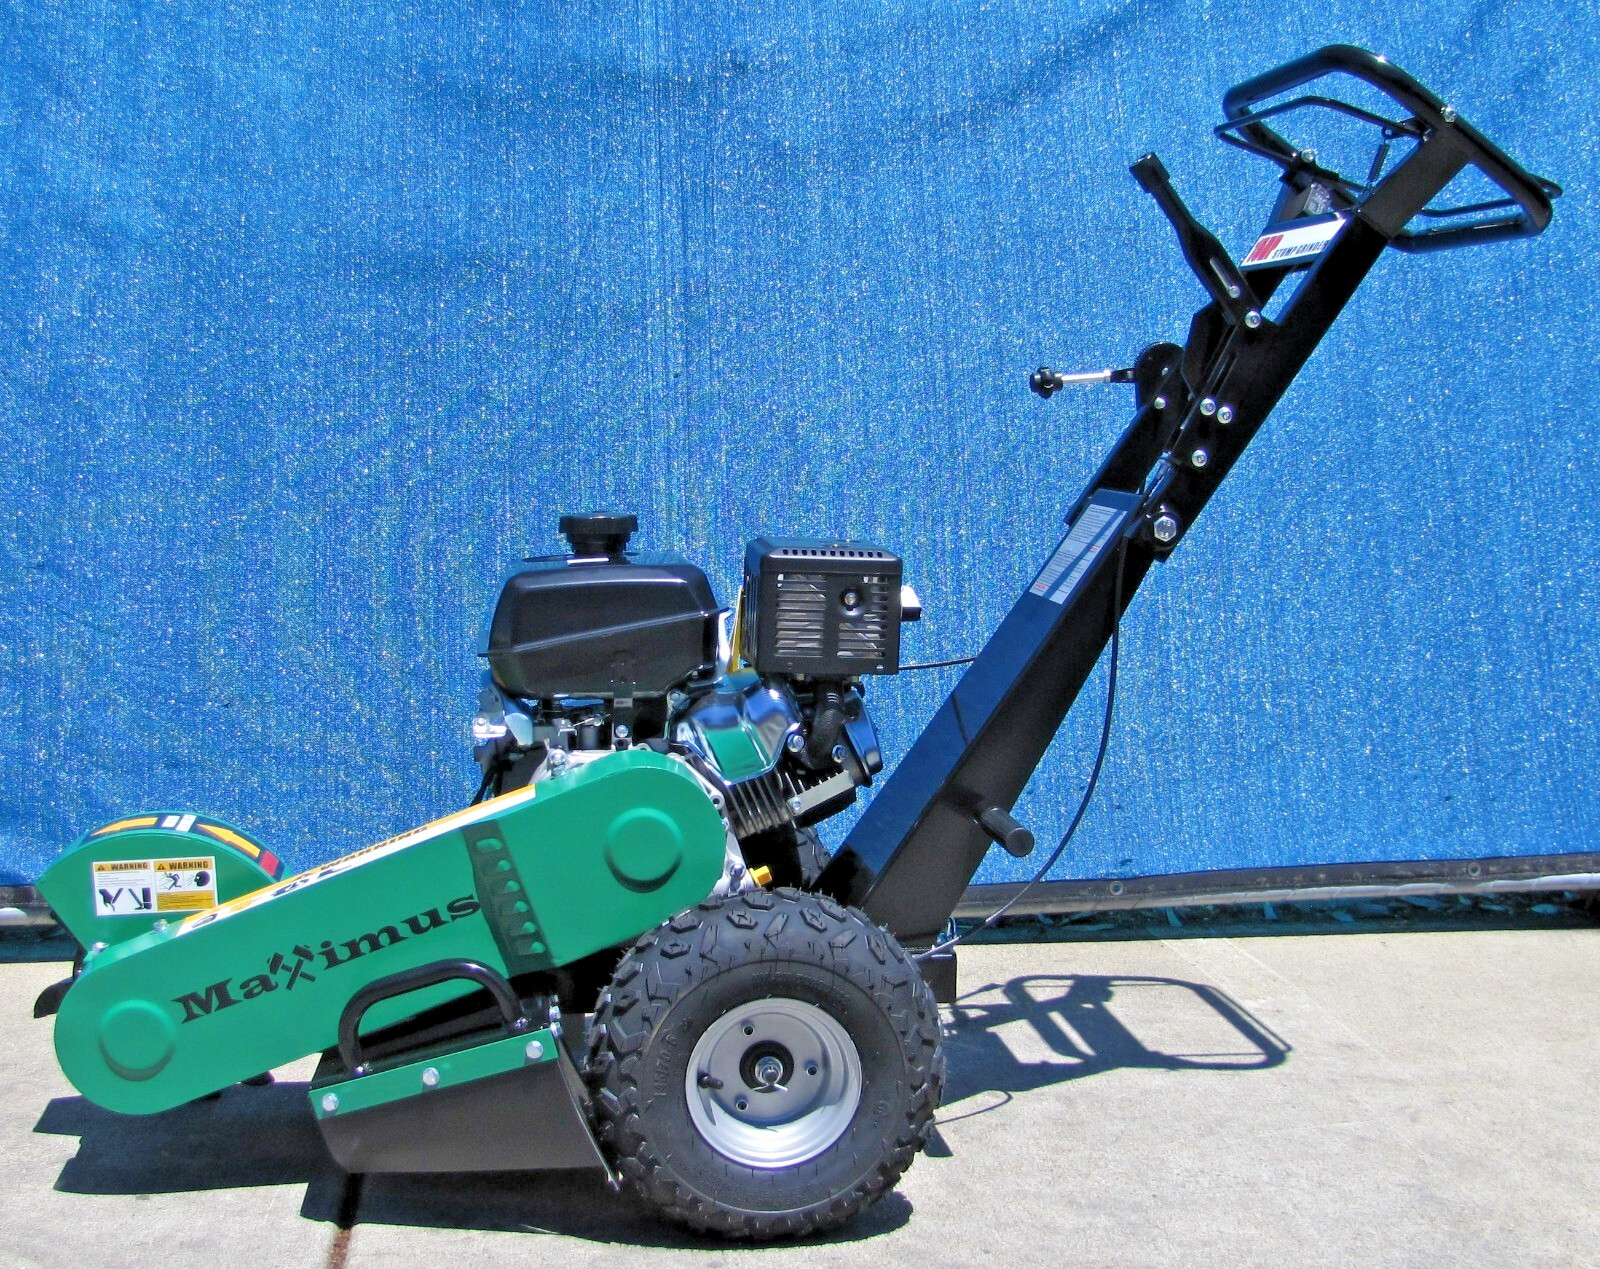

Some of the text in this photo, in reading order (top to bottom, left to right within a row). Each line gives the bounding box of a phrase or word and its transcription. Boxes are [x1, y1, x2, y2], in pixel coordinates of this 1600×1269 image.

[1271, 246, 1298, 259] STUMP
[111, 862, 148, 871] WARNING
[169, 860, 209, 870] WARNING
